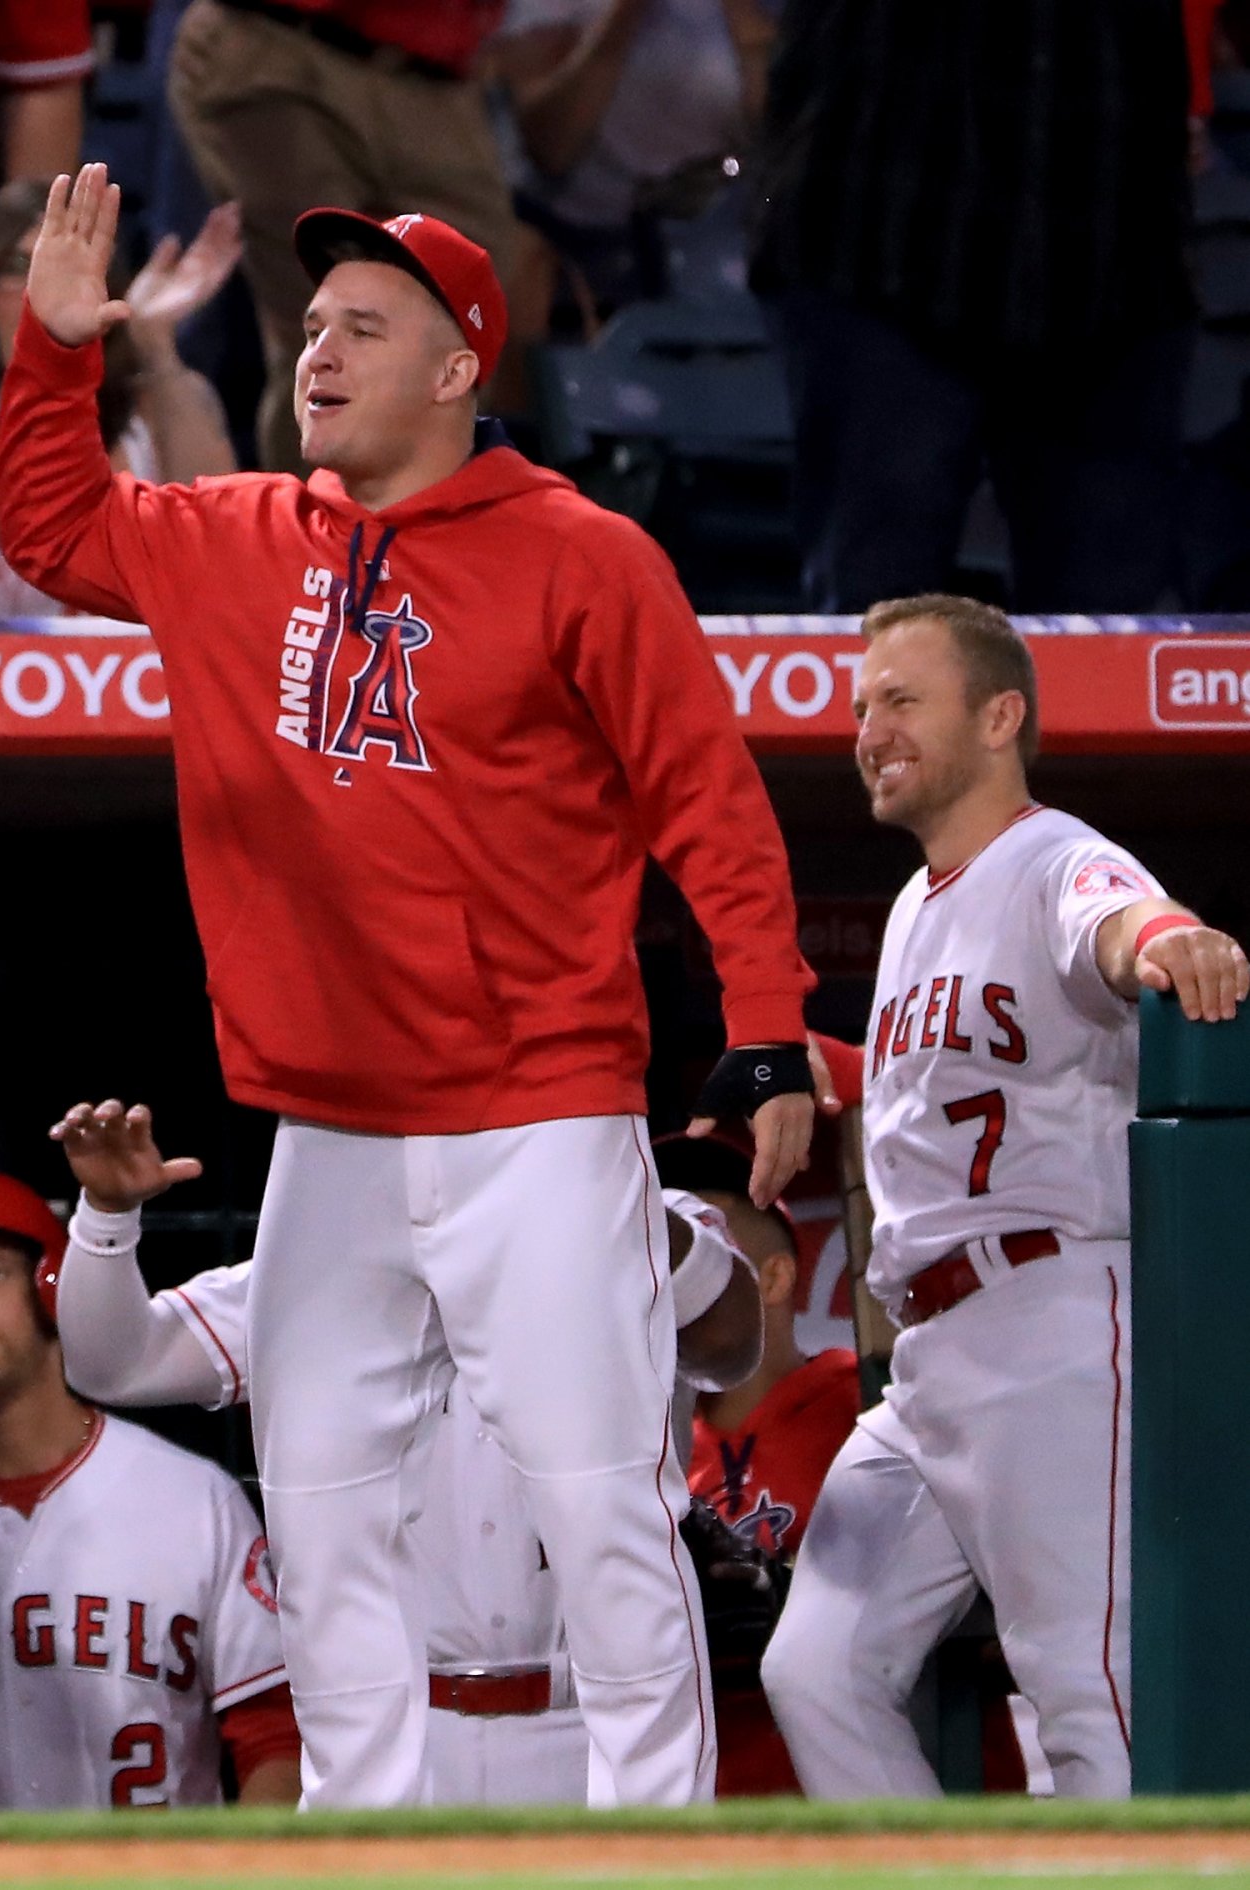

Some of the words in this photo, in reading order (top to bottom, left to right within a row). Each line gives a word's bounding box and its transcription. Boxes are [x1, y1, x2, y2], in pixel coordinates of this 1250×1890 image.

[276, 566, 333, 748] ANGELS
[325, 593, 437, 772] A
[943, 1088, 1008, 1198] 7
[111, 1722, 168, 1812] 2
